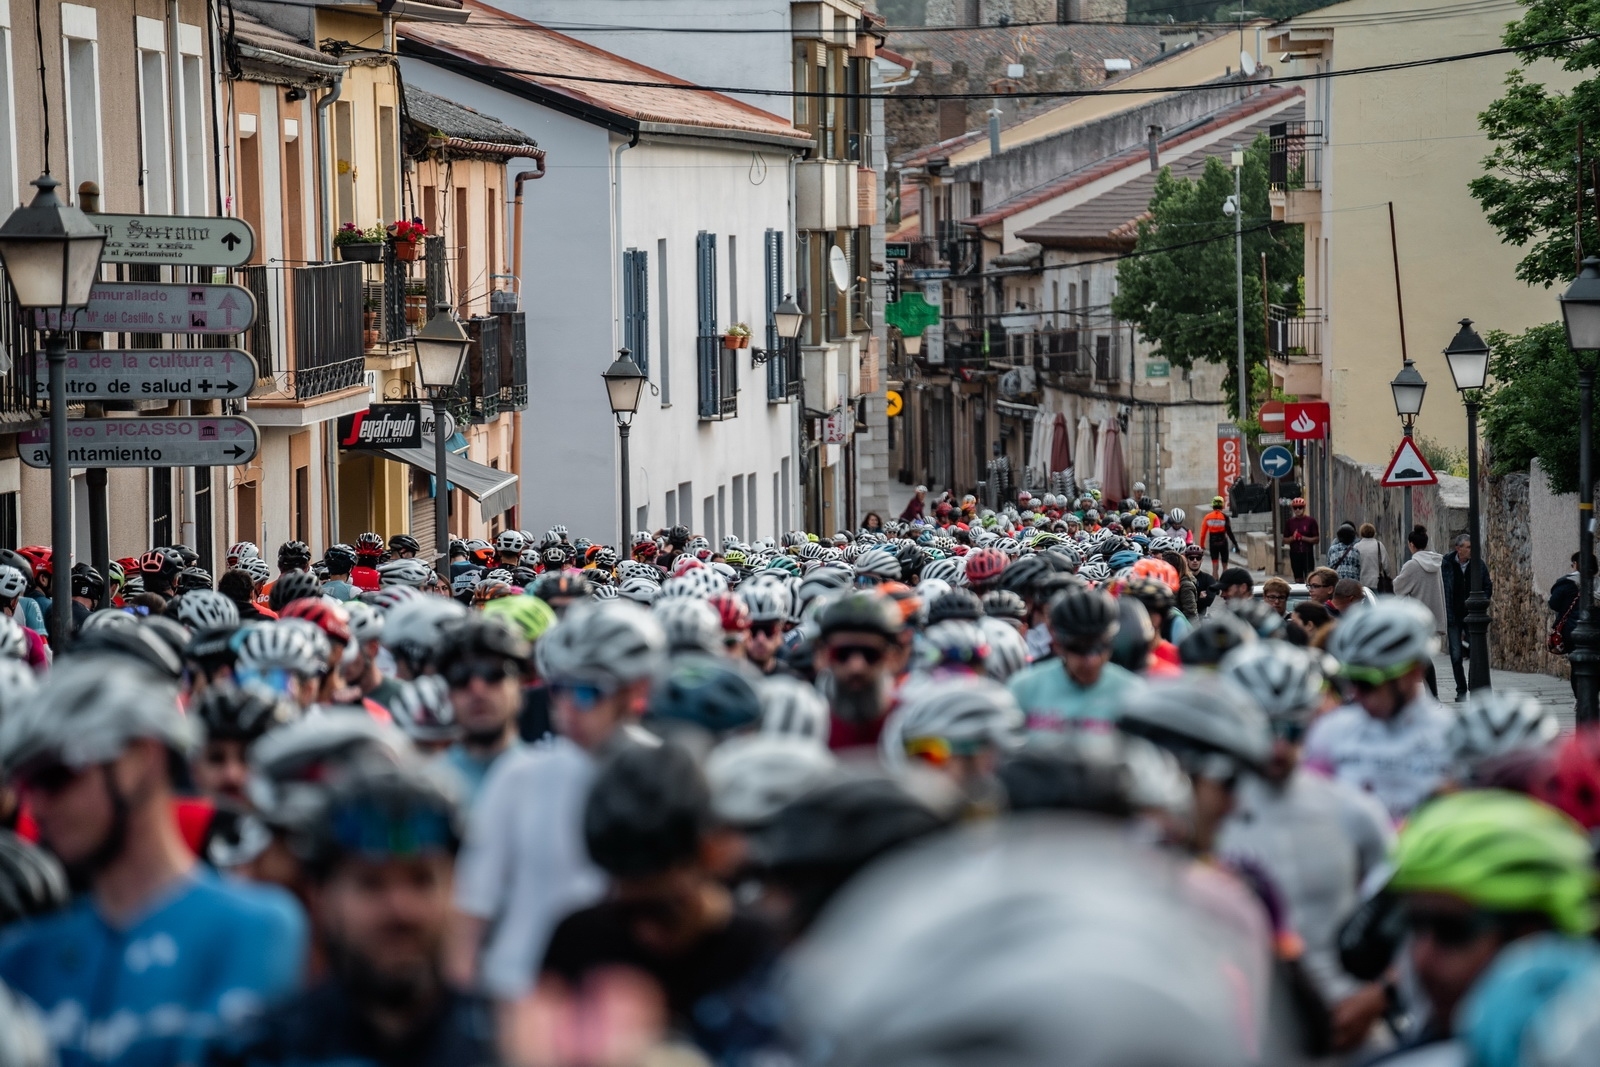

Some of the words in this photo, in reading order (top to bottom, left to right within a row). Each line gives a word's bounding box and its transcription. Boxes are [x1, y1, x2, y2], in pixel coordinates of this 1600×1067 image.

[127, 219, 210, 241] Serrano
[90, 289, 168, 302] amurallado
[103, 312, 117, 323] del
[121, 312, 153, 324] Castillo
[157, 313, 166, 324] S.
[89, 354, 112, 369] de
[122, 353, 138, 368] la
[149, 352, 213, 368] cultura
[36, 380, 97, 393] ctro
[107, 379, 130, 393] de
[141, 379, 191, 393] salud
[105, 422, 192, 437] PICASSO
[342, 409, 415, 445] Segafredo
[33, 446, 162, 466] ayntamiento
